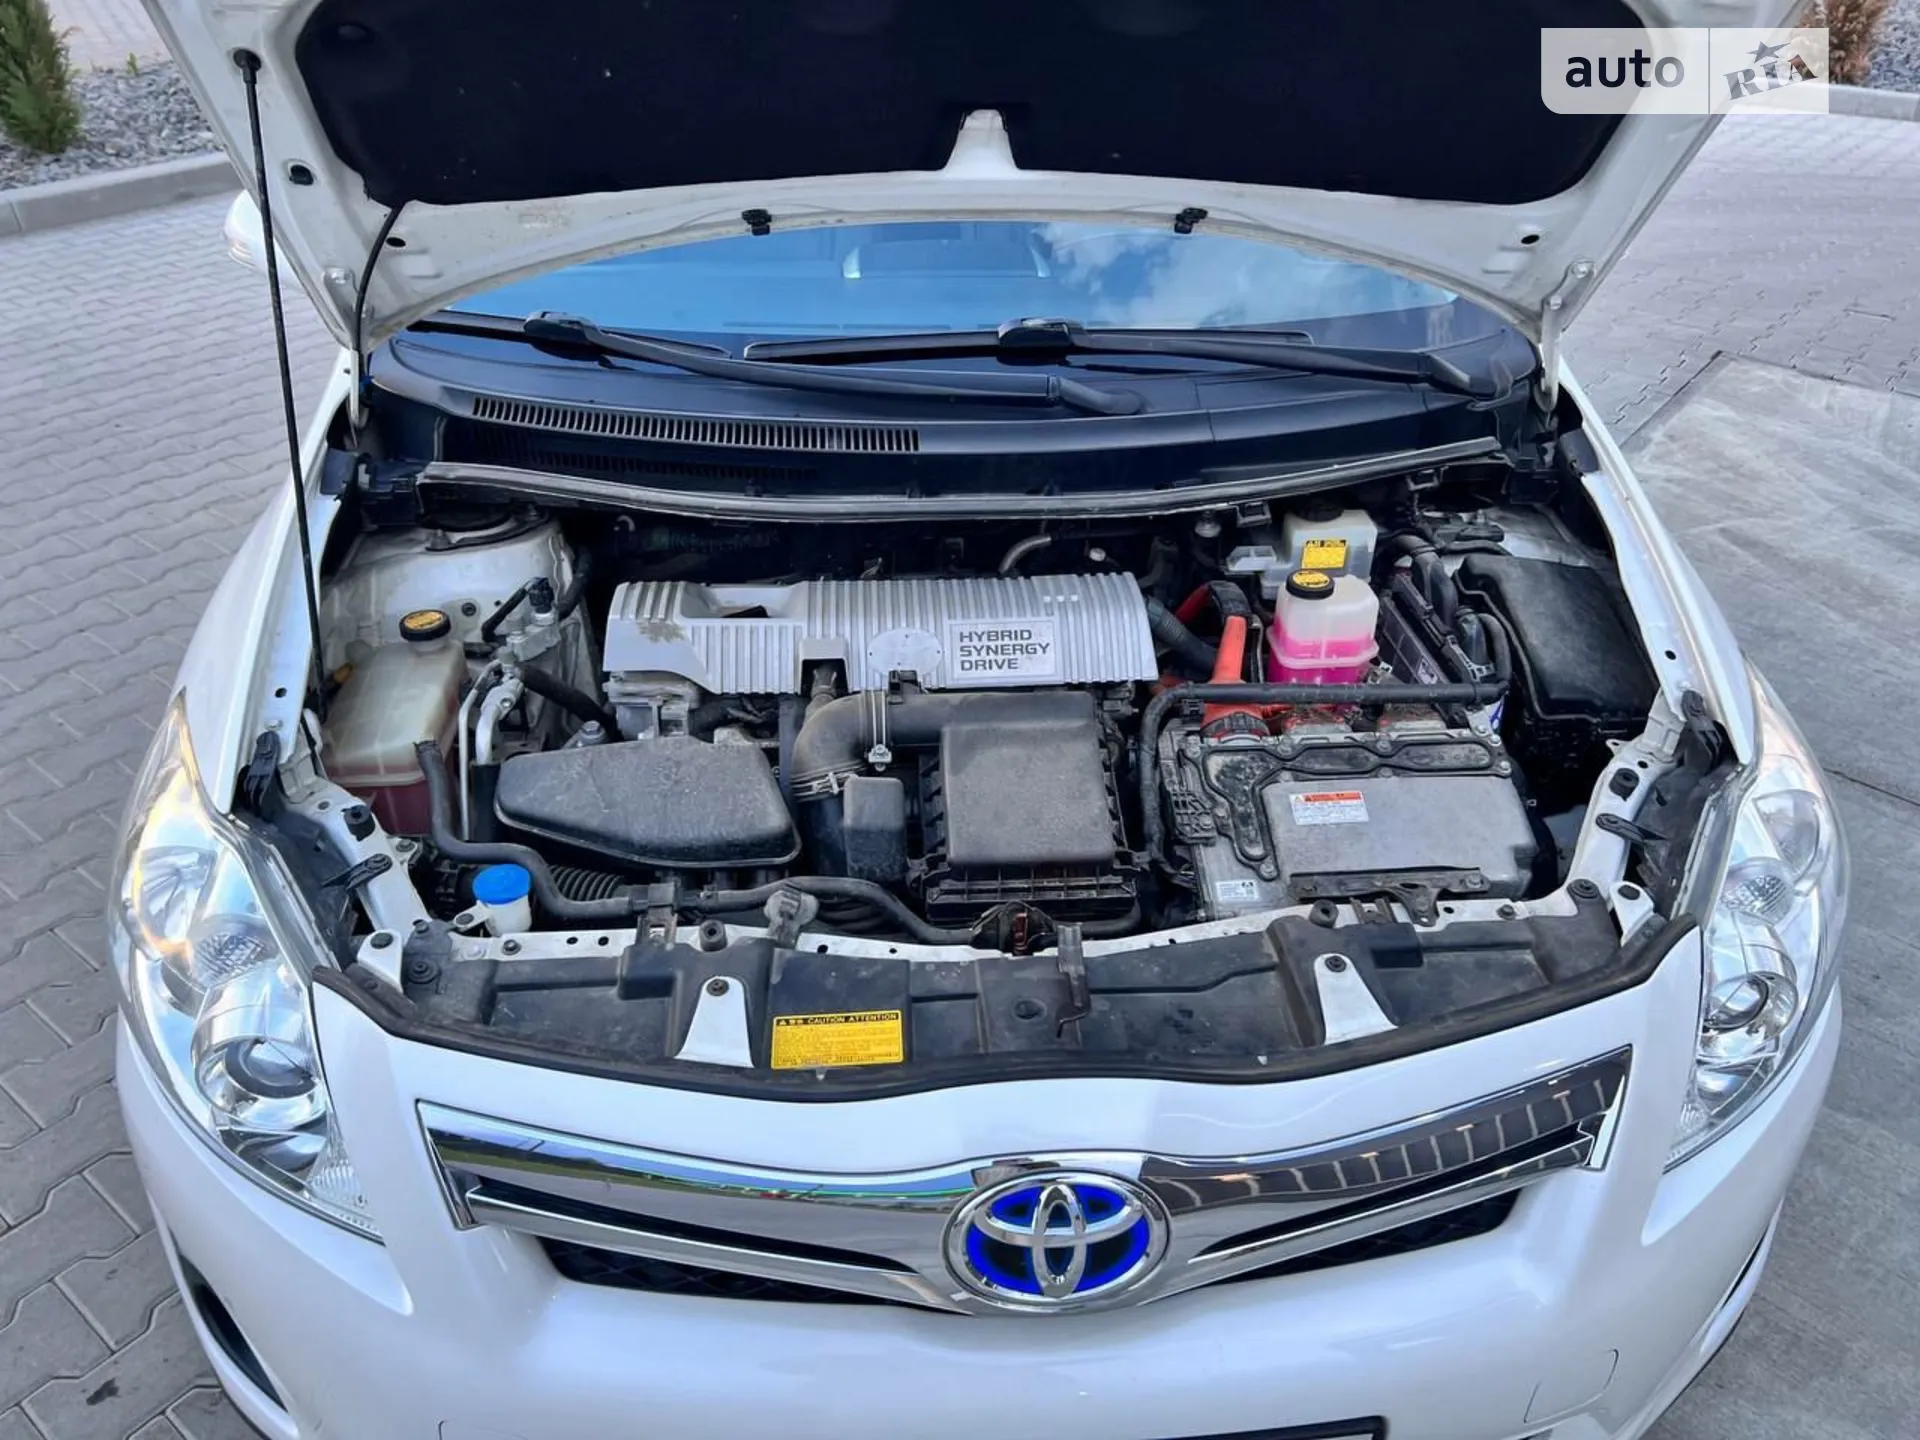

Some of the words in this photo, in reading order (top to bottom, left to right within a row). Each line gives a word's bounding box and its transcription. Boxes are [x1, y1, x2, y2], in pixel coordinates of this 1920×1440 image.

[960, 630, 1032, 642] HYBRID
[960, 643, 1050, 657] SYNERGY
[961, 658, 1019, 671] DRIVE
[808, 1016, 845, 1025] CAUTION
[848, 1012, 897, 1022] ATTENTION
